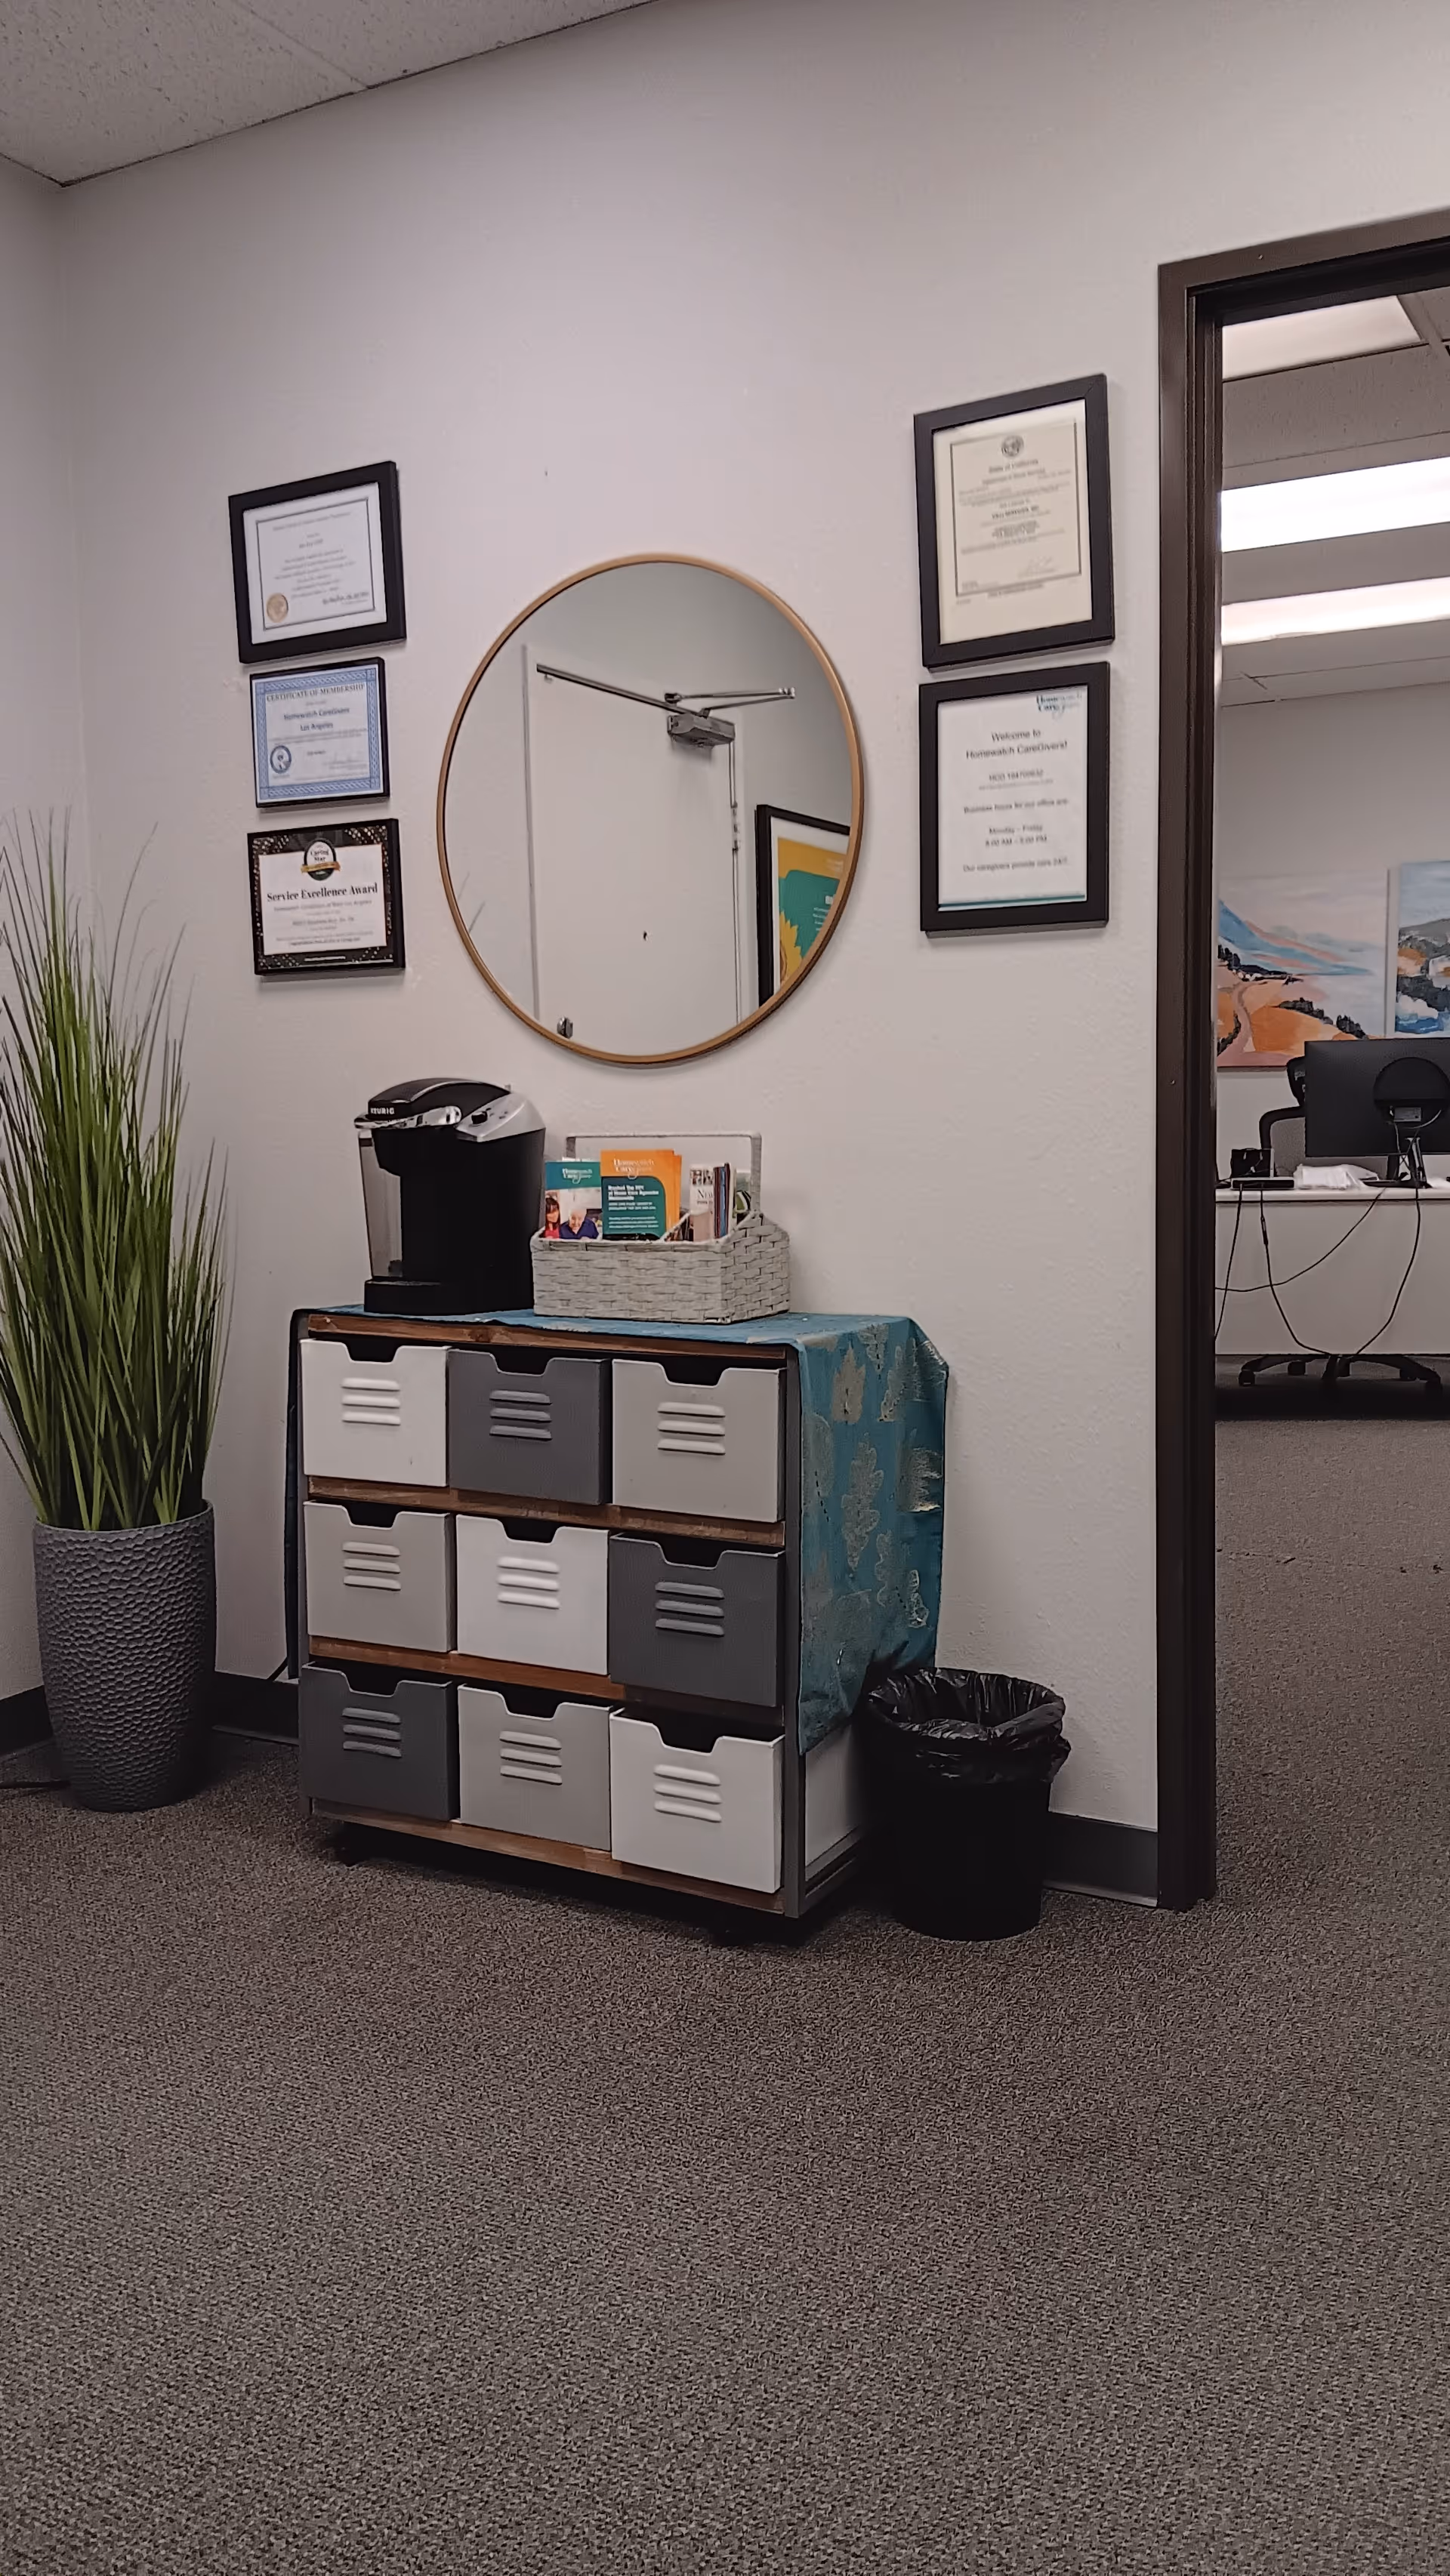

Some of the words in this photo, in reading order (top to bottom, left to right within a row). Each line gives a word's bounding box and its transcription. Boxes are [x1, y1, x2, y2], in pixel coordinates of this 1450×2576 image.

[267, 690, 307, 701] CERTIFICATE
[310, 689, 318, 697] OF
[992, 731, 1030, 742] Welcome
[1032, 729, 1041, 738] to
[966, 747, 1015, 760] Homewatch
[267, 890, 299, 902] Service
[301, 886, 347, 898] Excellence
[350, 881, 378, 895] Award
